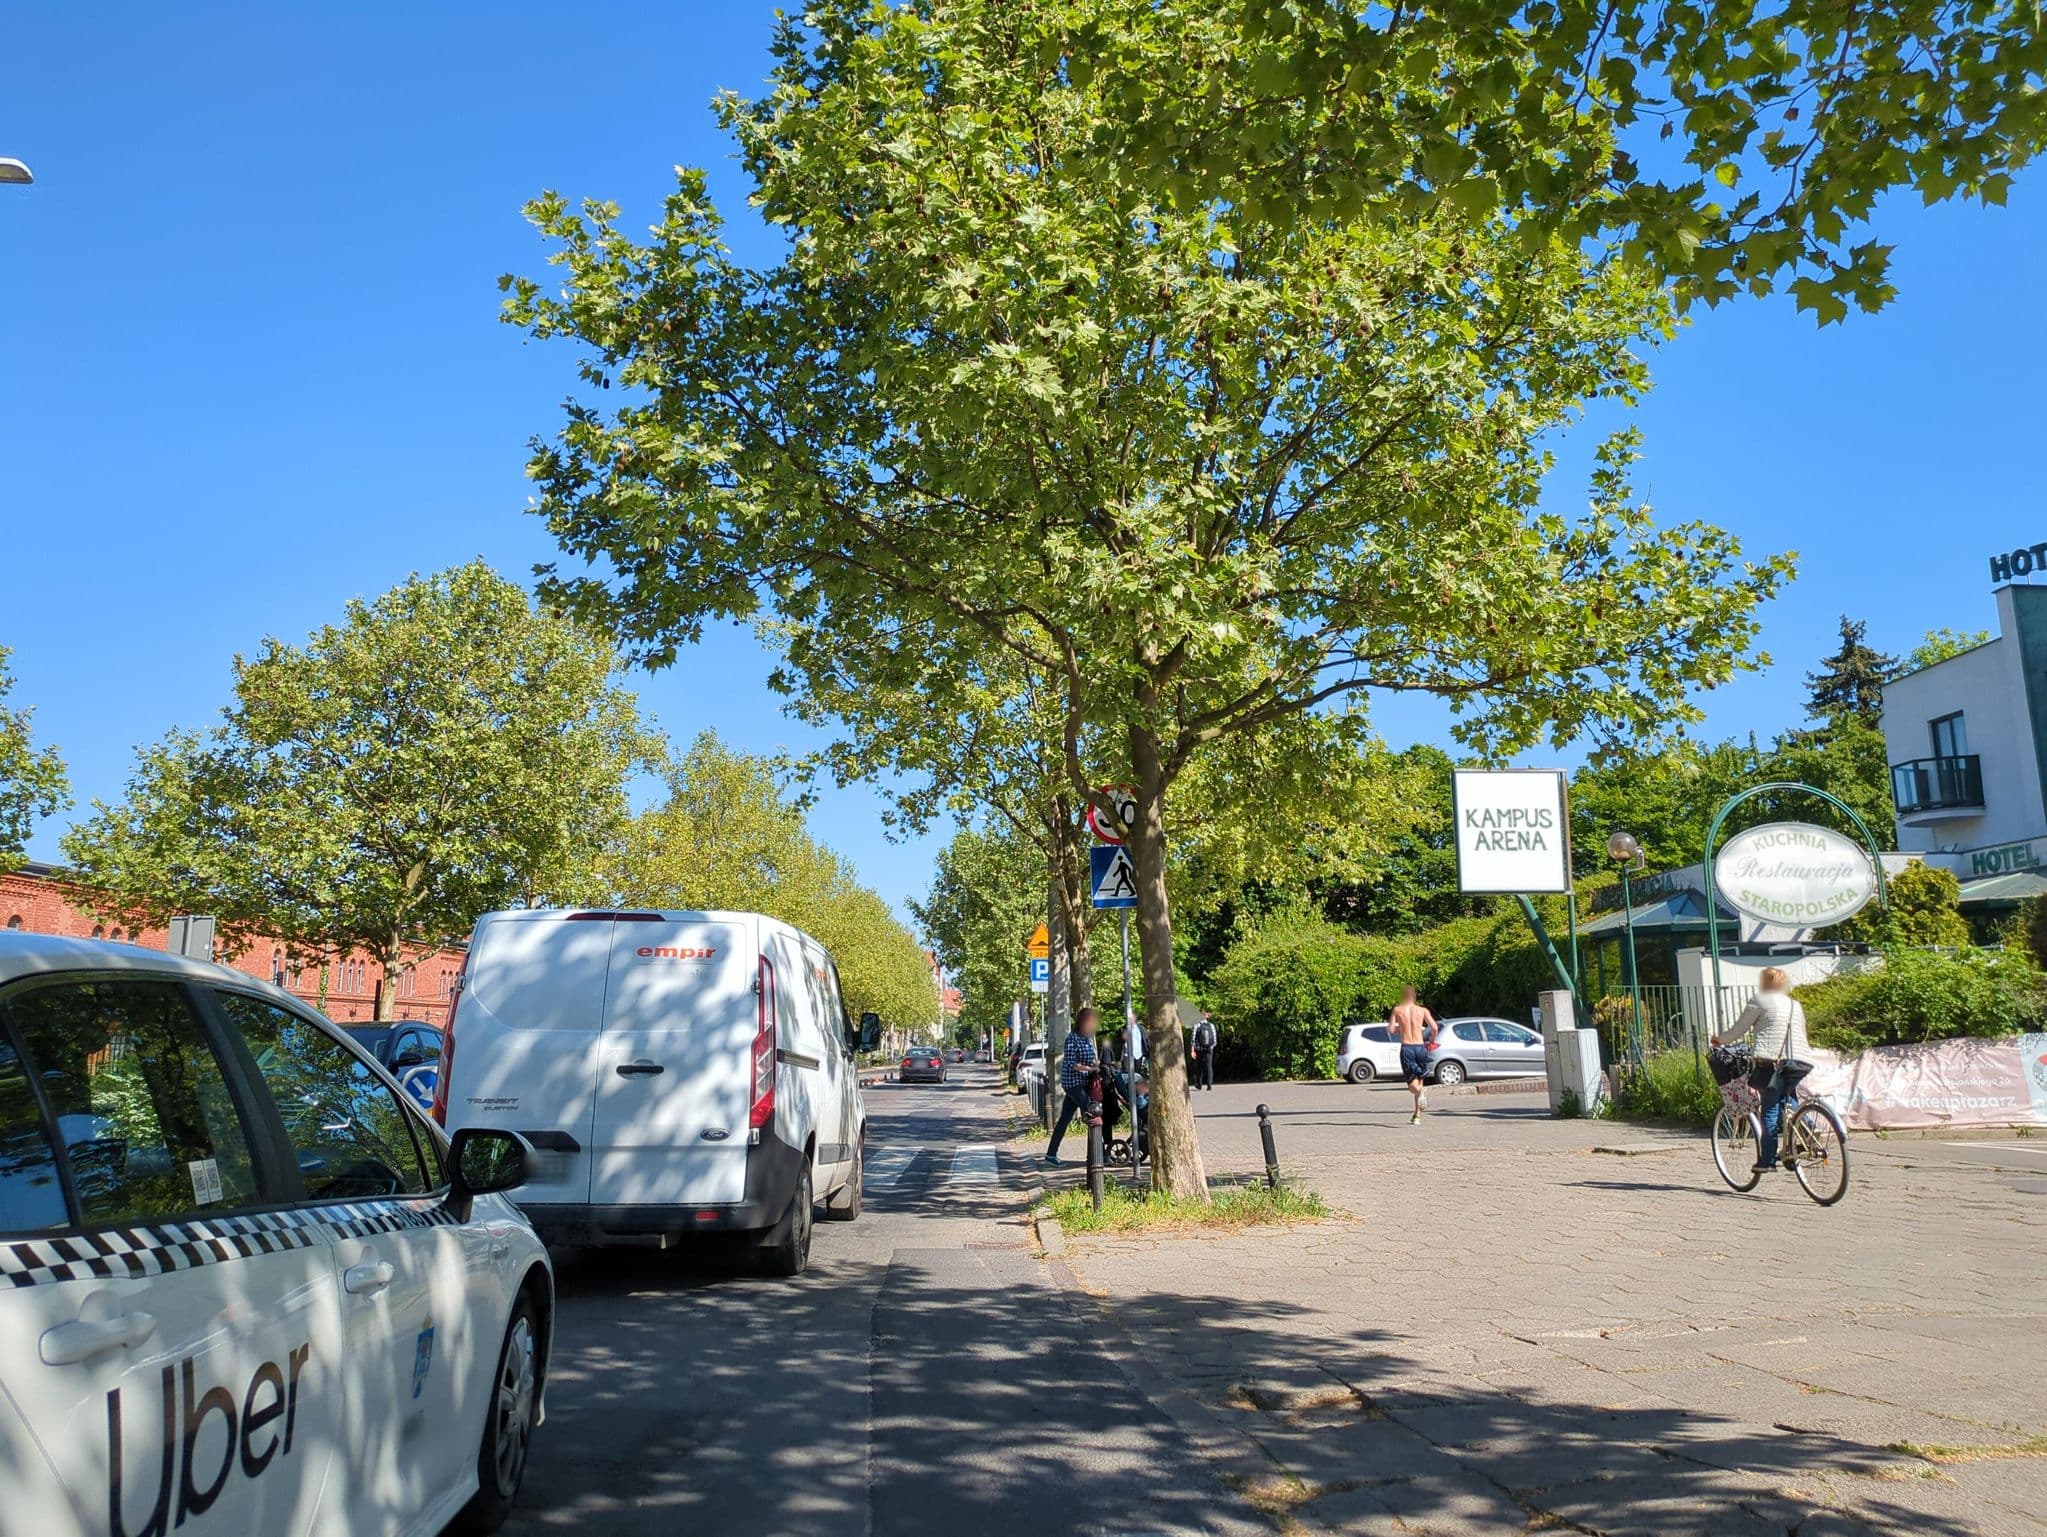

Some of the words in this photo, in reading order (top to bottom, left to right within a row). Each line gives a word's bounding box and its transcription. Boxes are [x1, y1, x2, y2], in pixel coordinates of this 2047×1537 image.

[1990, 543, 2047, 583] HOT
[1465, 808, 1553, 829] KAMPUS
[1474, 830, 1548, 852] ARENA
[1752, 833, 1827, 852] KUCHNIA
[1734, 856, 1855, 886] Restauracja
[1972, 843, 2039, 875] HOTEL
[1738, 888, 1858, 918] STAROPOLSKA
[637, 947, 716, 960] empir
[107, 1342, 309, 1537] Uber
